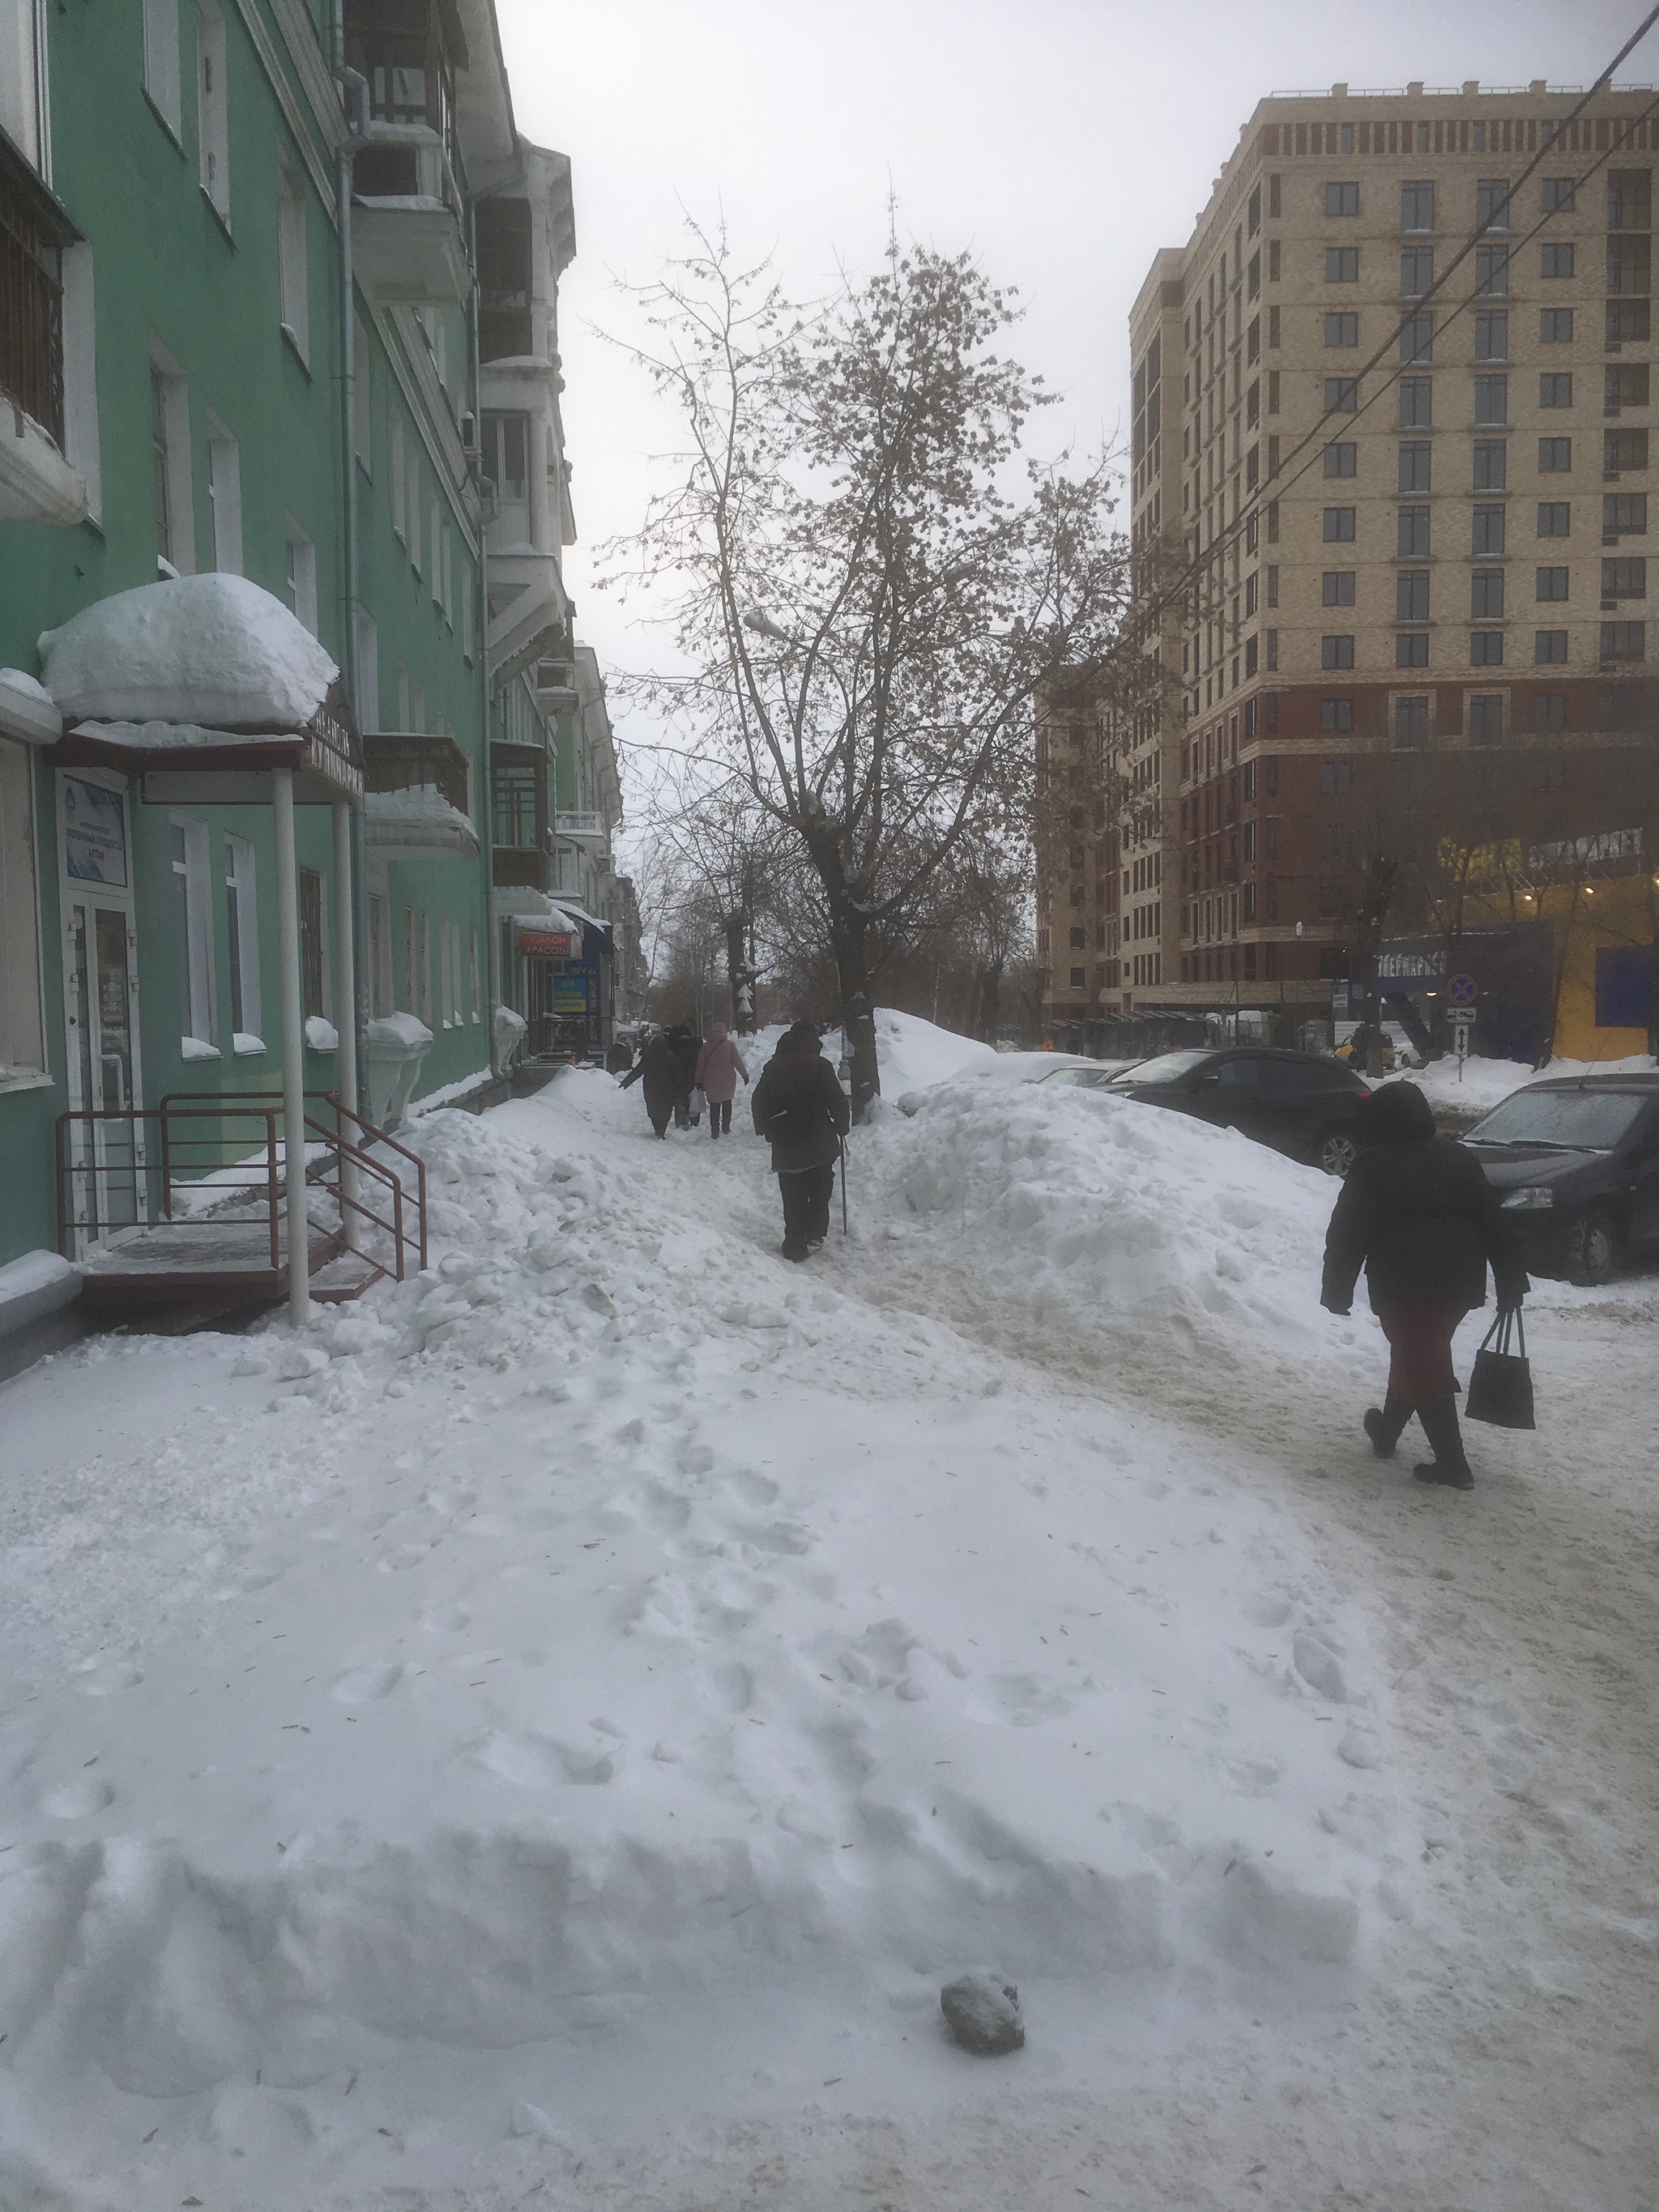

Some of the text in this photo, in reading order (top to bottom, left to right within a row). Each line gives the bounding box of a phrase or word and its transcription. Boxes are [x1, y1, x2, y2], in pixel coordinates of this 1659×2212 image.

[312, 735, 364, 798] КУЛИНАРИЯ
[66, 827, 122, 851] МОЛОЧНЫЕ ПРОДУКТЫ
[531, 936, 565, 944] САЛОН
[527, 946, 569, 955] КРАСОТЫ
